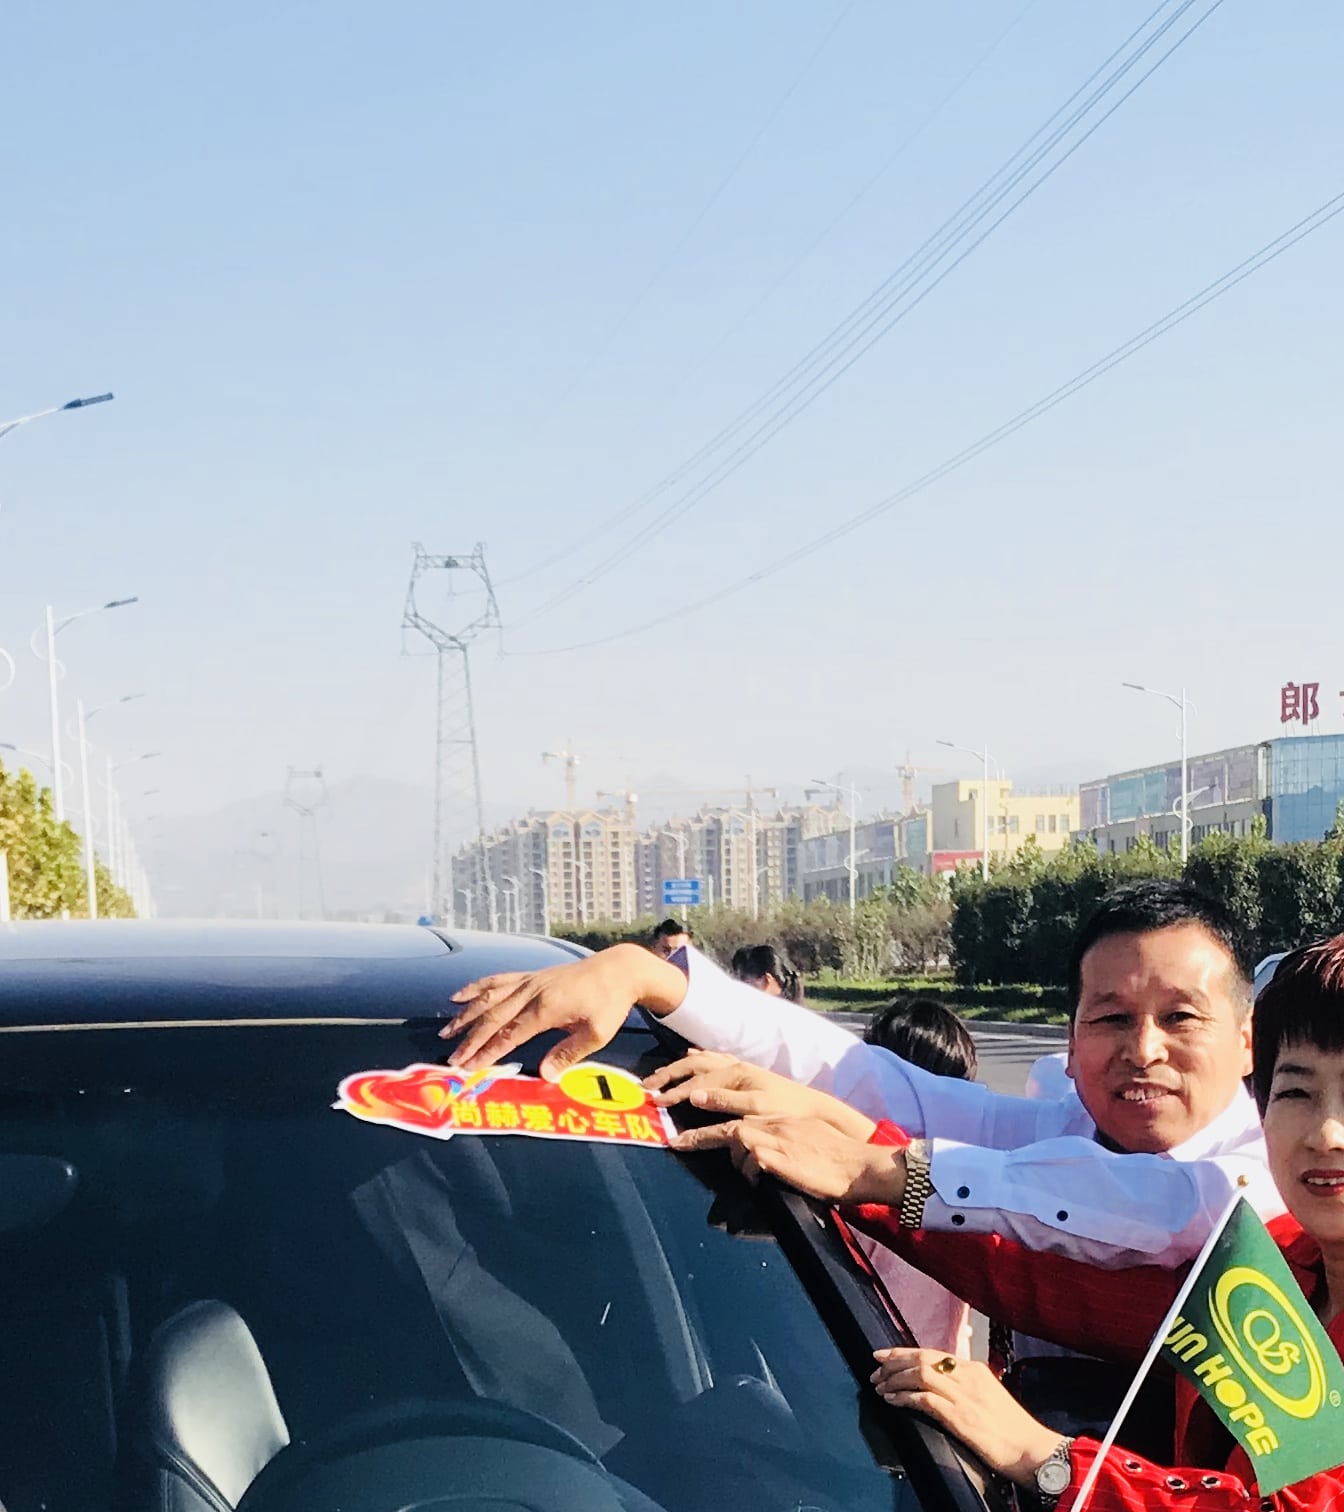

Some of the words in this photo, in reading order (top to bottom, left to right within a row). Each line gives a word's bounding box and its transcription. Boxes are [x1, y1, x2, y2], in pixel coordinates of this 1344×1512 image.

[586, 1074, 624, 1104] 1
[452, 1101, 661, 1142] 尚赫爱心车队
[1194, 1354, 1279, 1456] HOPE
